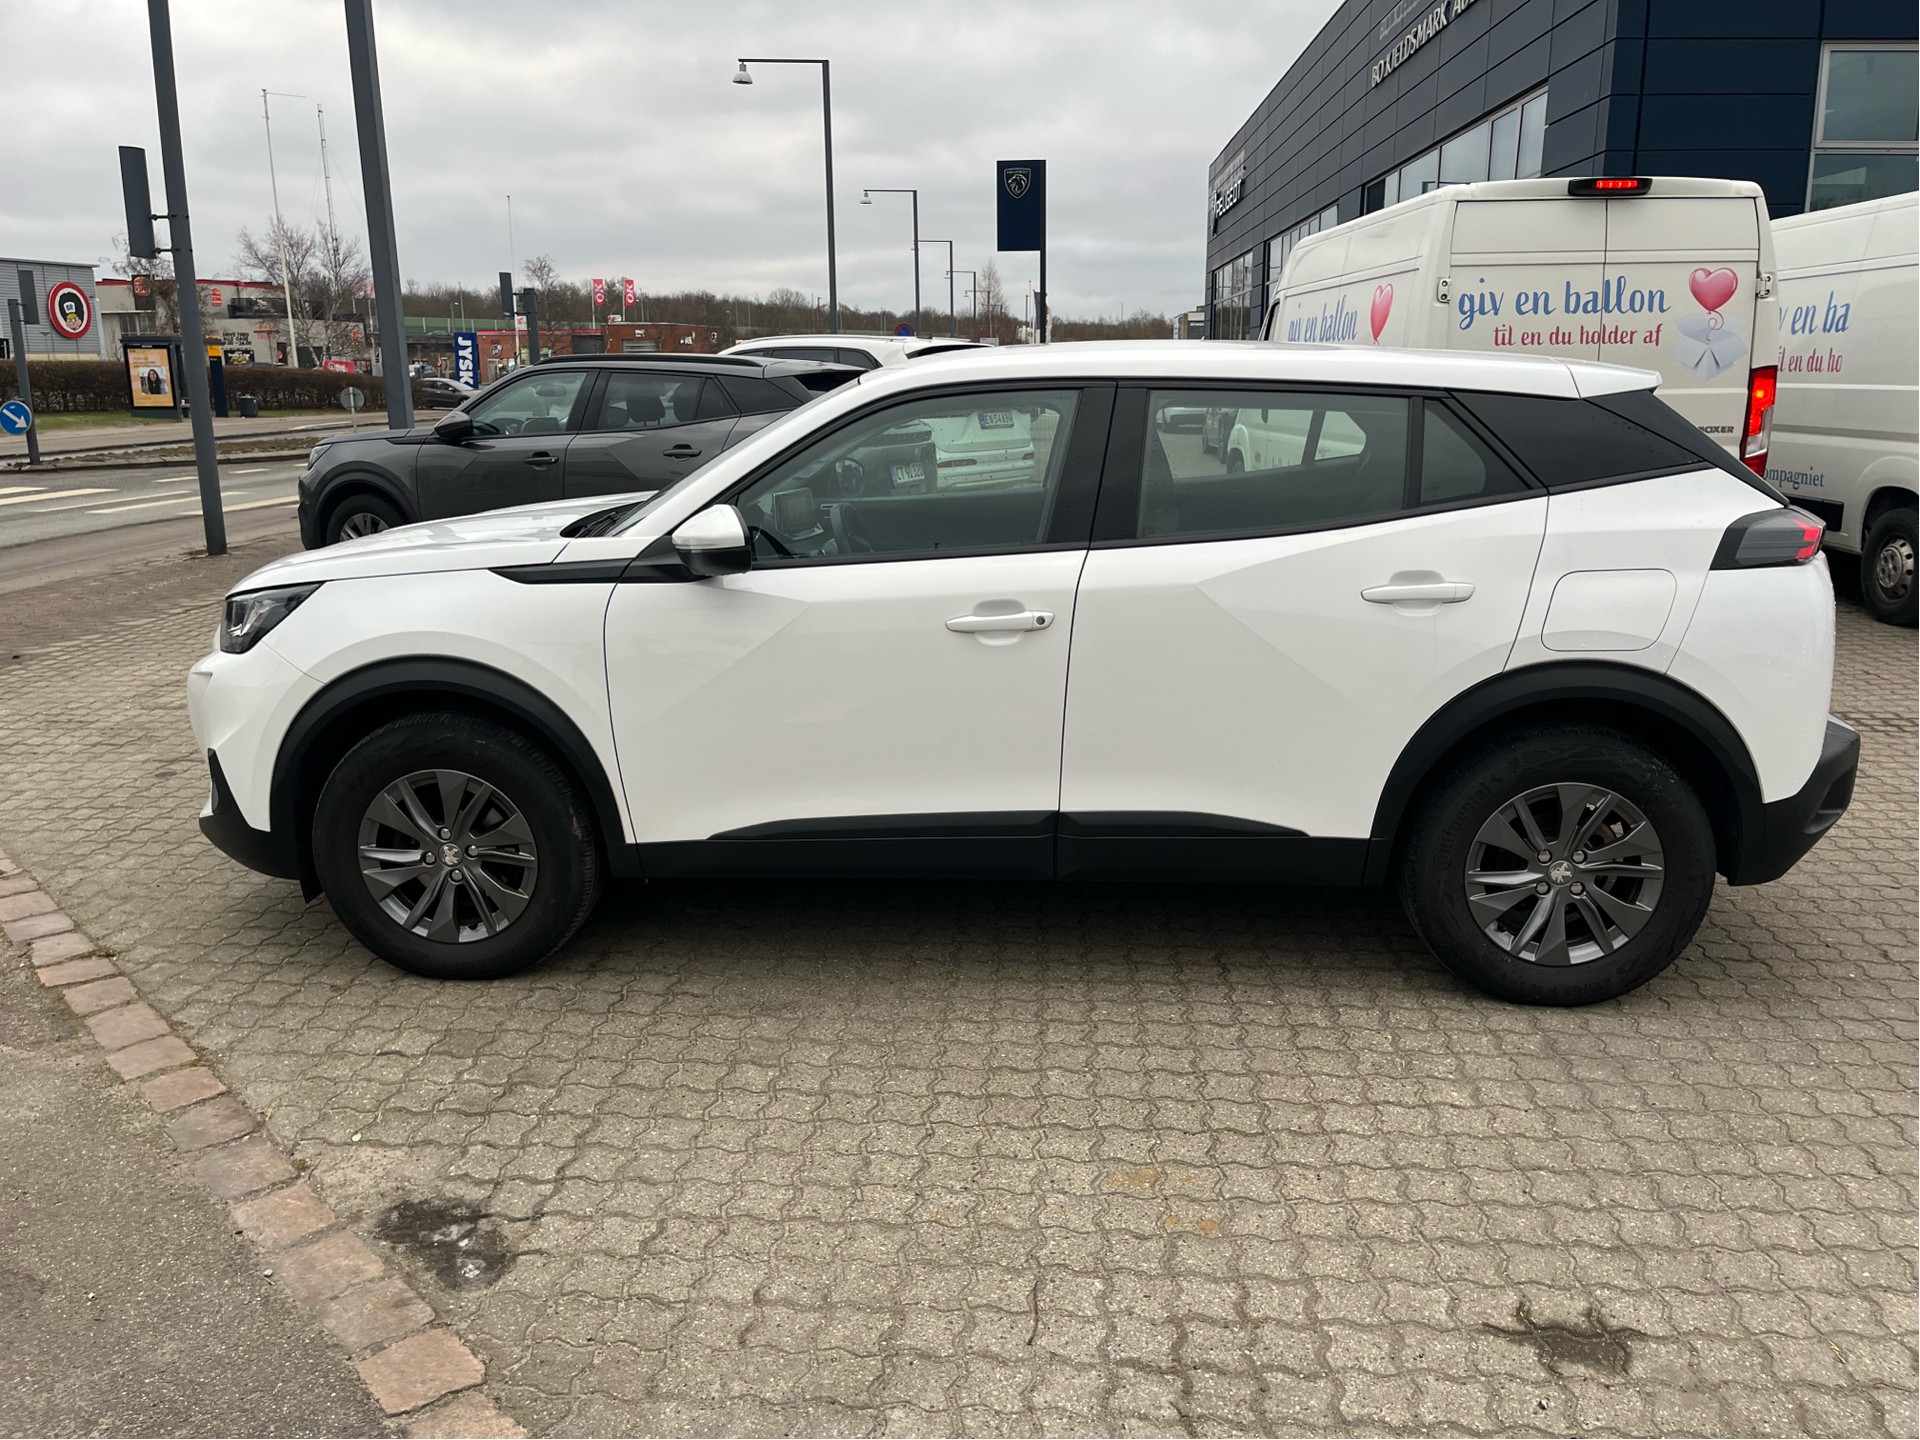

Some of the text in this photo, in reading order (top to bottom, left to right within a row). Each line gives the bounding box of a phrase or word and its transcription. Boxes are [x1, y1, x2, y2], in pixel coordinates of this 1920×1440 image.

[1371, 60, 1384, 87] BO
[594, 283, 605, 303] OK
[625, 283, 635, 304] OK
[1458, 275, 1671, 331] giv en ballon
[1304, 316, 1318, 342] en
[1319, 294, 1358, 342] ballon
[1791, 305, 1818, 335] en
[1822, 290, 1850, 333] ba
[1494, 323, 1663, 347] til en du holder af
[457, 336, 474, 387] JYSK
[1777, 346, 1843, 373] il en du ho
[1763, 466, 1824, 490] ompagniet
